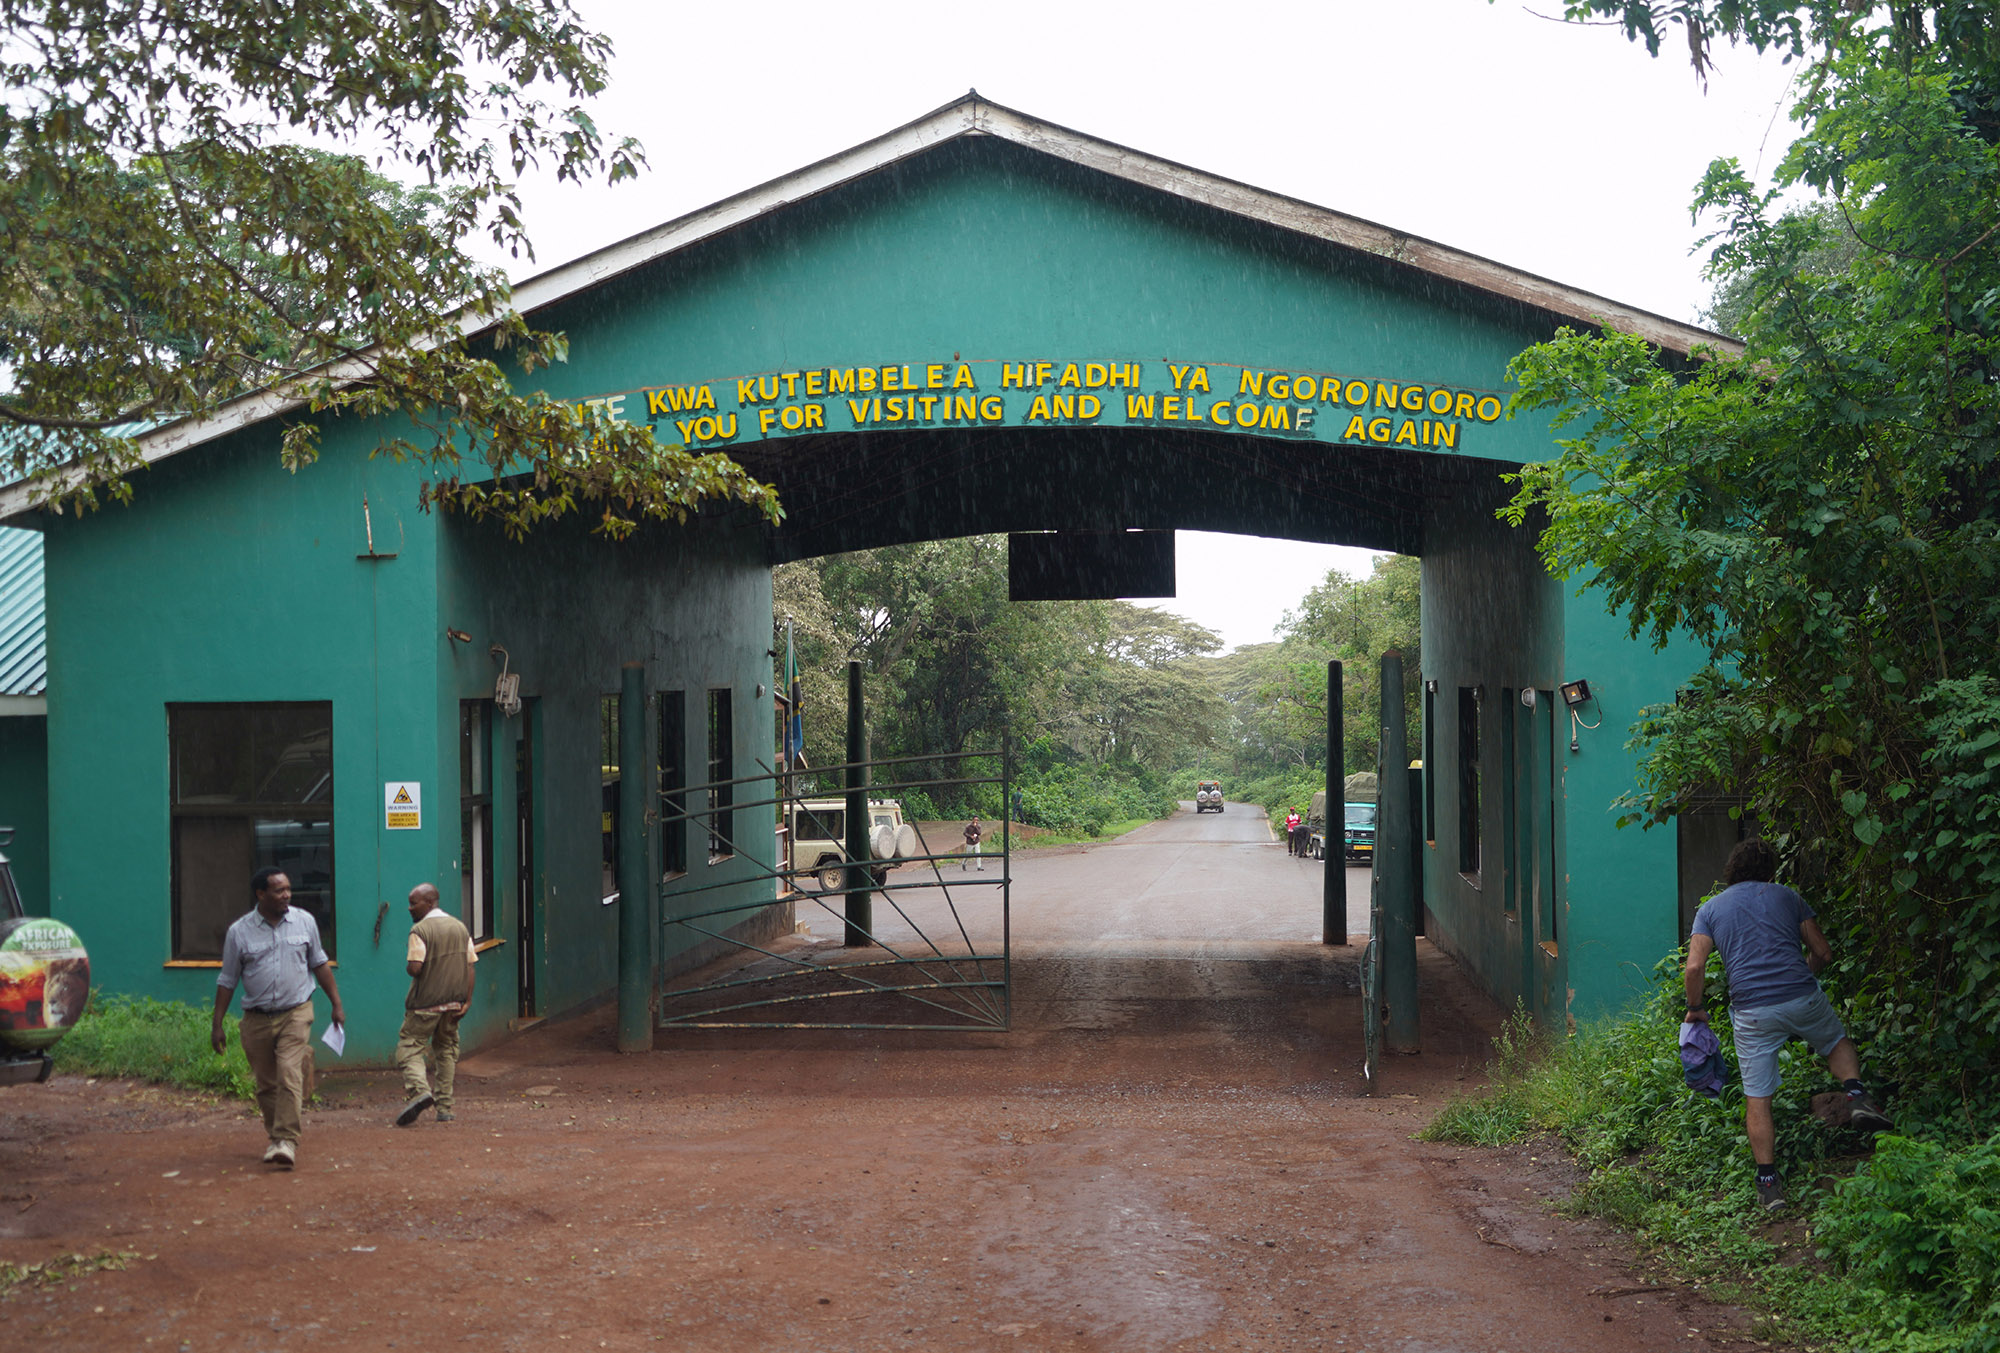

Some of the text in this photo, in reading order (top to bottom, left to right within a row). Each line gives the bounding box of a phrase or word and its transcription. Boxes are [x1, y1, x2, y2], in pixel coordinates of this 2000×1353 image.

[648, 386, 716, 415] KWA
[737, 364, 975, 403] KUTEMBELEA
[1002, 362, 1140, 388] HIFADHI
[1169, 365, 1210, 393] YA
[1239, 370, 1502, 421] NGORONGORO
[676, 414, 737, 444] YOU
[758, 404, 824, 433] FOR
[848, 396, 1002, 424] VISITING
[1029, 394, 1101, 420] AND
[1127, 394, 1313, 431] WELCOME
[1344, 415, 1456, 447] AGAIN
[15, 928, 74, 942] AFRICAN
[22, 939, 71, 950] EXPOSURE
